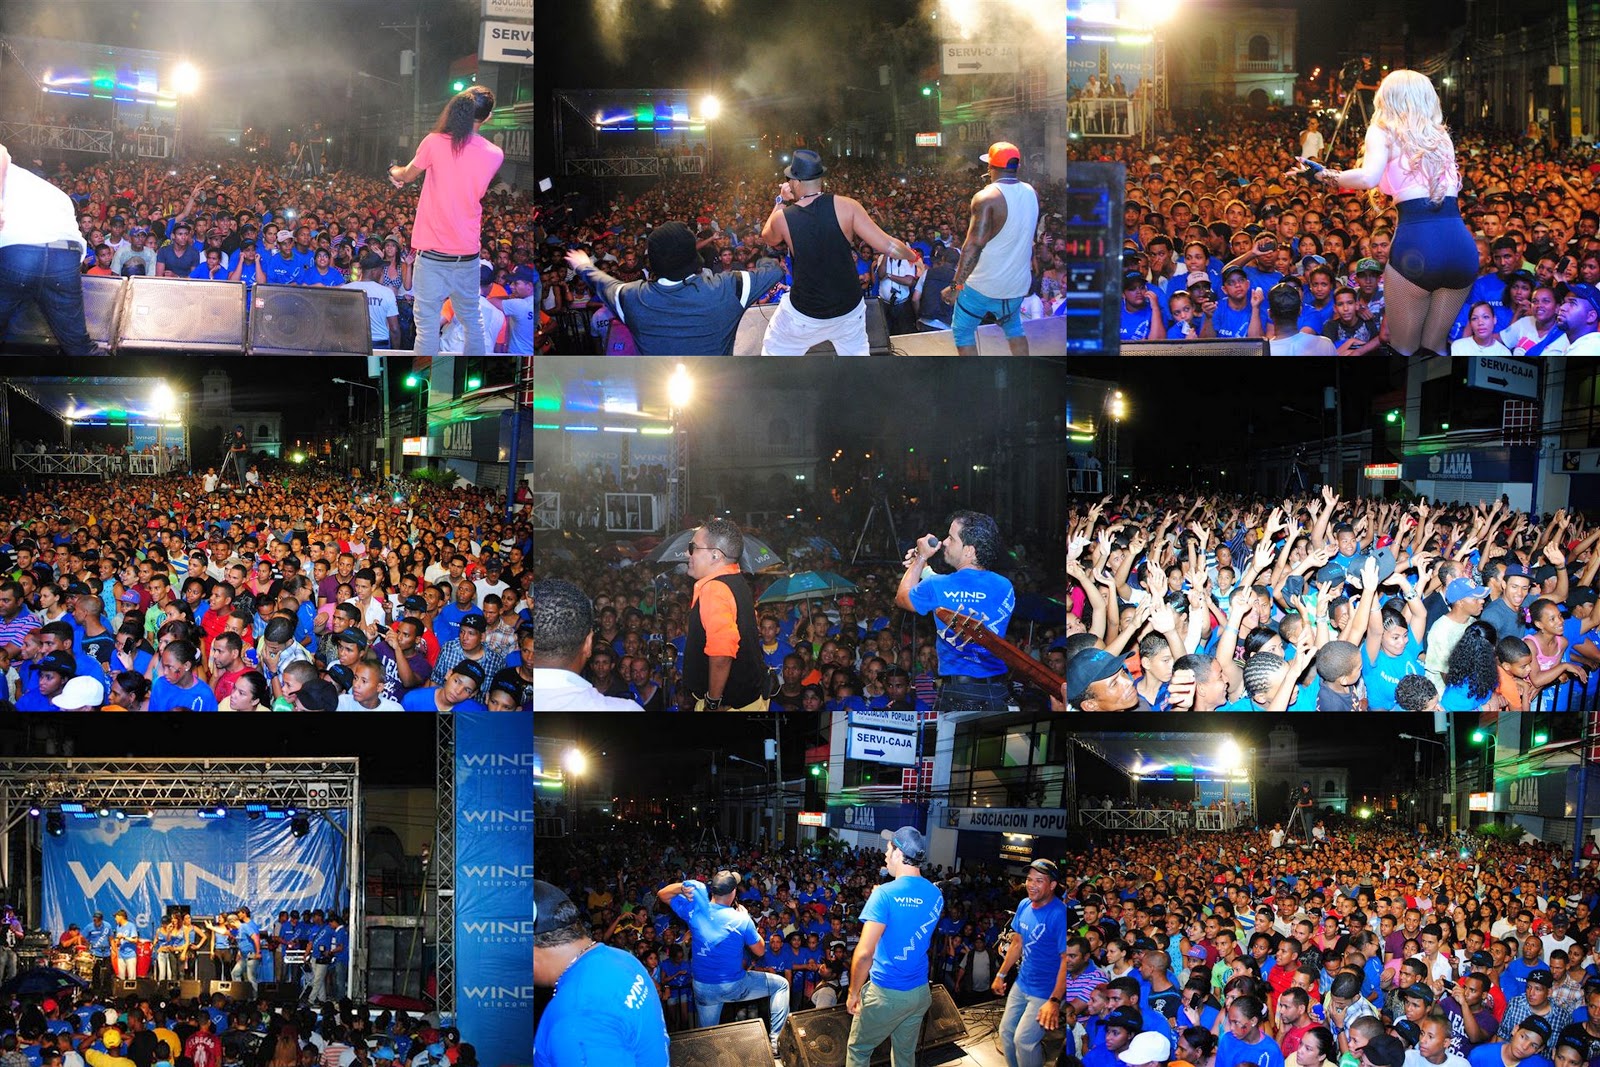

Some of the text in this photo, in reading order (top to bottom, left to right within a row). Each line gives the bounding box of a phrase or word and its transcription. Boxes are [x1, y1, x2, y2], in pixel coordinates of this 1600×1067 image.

[1111, 62, 1153, 71] WIND
[1480, 357, 1535, 379] SERVI-CAJA
[452, 422, 472, 451] LAMA
[577, 451, 618, 460] WIND
[1443, 453, 1473, 474] LAMA
[943, 590, 987, 600] WIND
[892, 711, 915, 723] POPULAR
[856, 732, 912, 749] SERVI-CAJA
[477, 768, 528, 776] telecom
[1519, 778, 1539, 806] LAMA
[854, 807, 875, 827] LAMA
[970, 812, 1028, 829] ASOCIACION
[477, 823, 528, 832] telecom
[66, 860, 325, 900] WIND
[477, 879, 528, 888] telecom
[893, 896, 924, 905] WIND
[477, 934, 528, 943] telecom
[624, 974, 645, 1009] WIND
[477, 1000, 528, 1009] telecom
